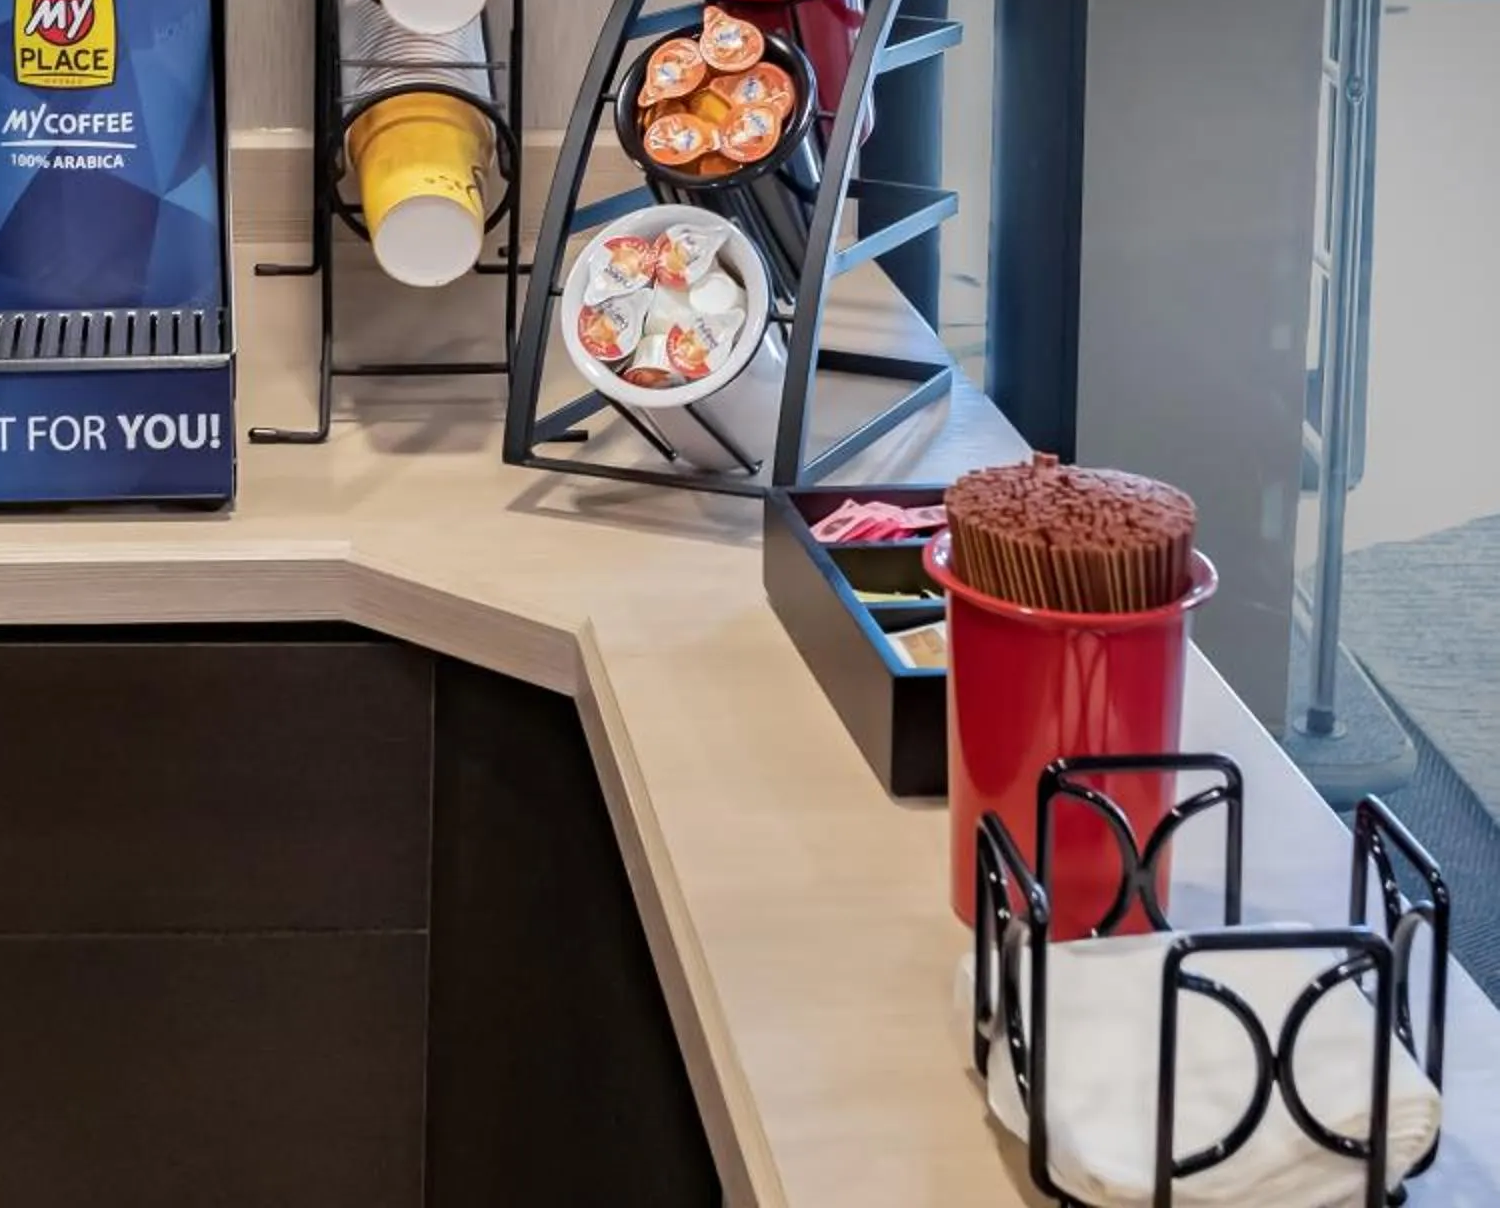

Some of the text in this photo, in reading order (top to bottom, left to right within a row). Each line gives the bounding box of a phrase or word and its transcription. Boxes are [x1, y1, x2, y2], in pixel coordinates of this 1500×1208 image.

[19, 47, 109, 71] PLACE
[11, 153, 126, 170] 100% ARABICA
[27, 416, 108, 452] FOR
[117, 413, 221, 451] YOU!
